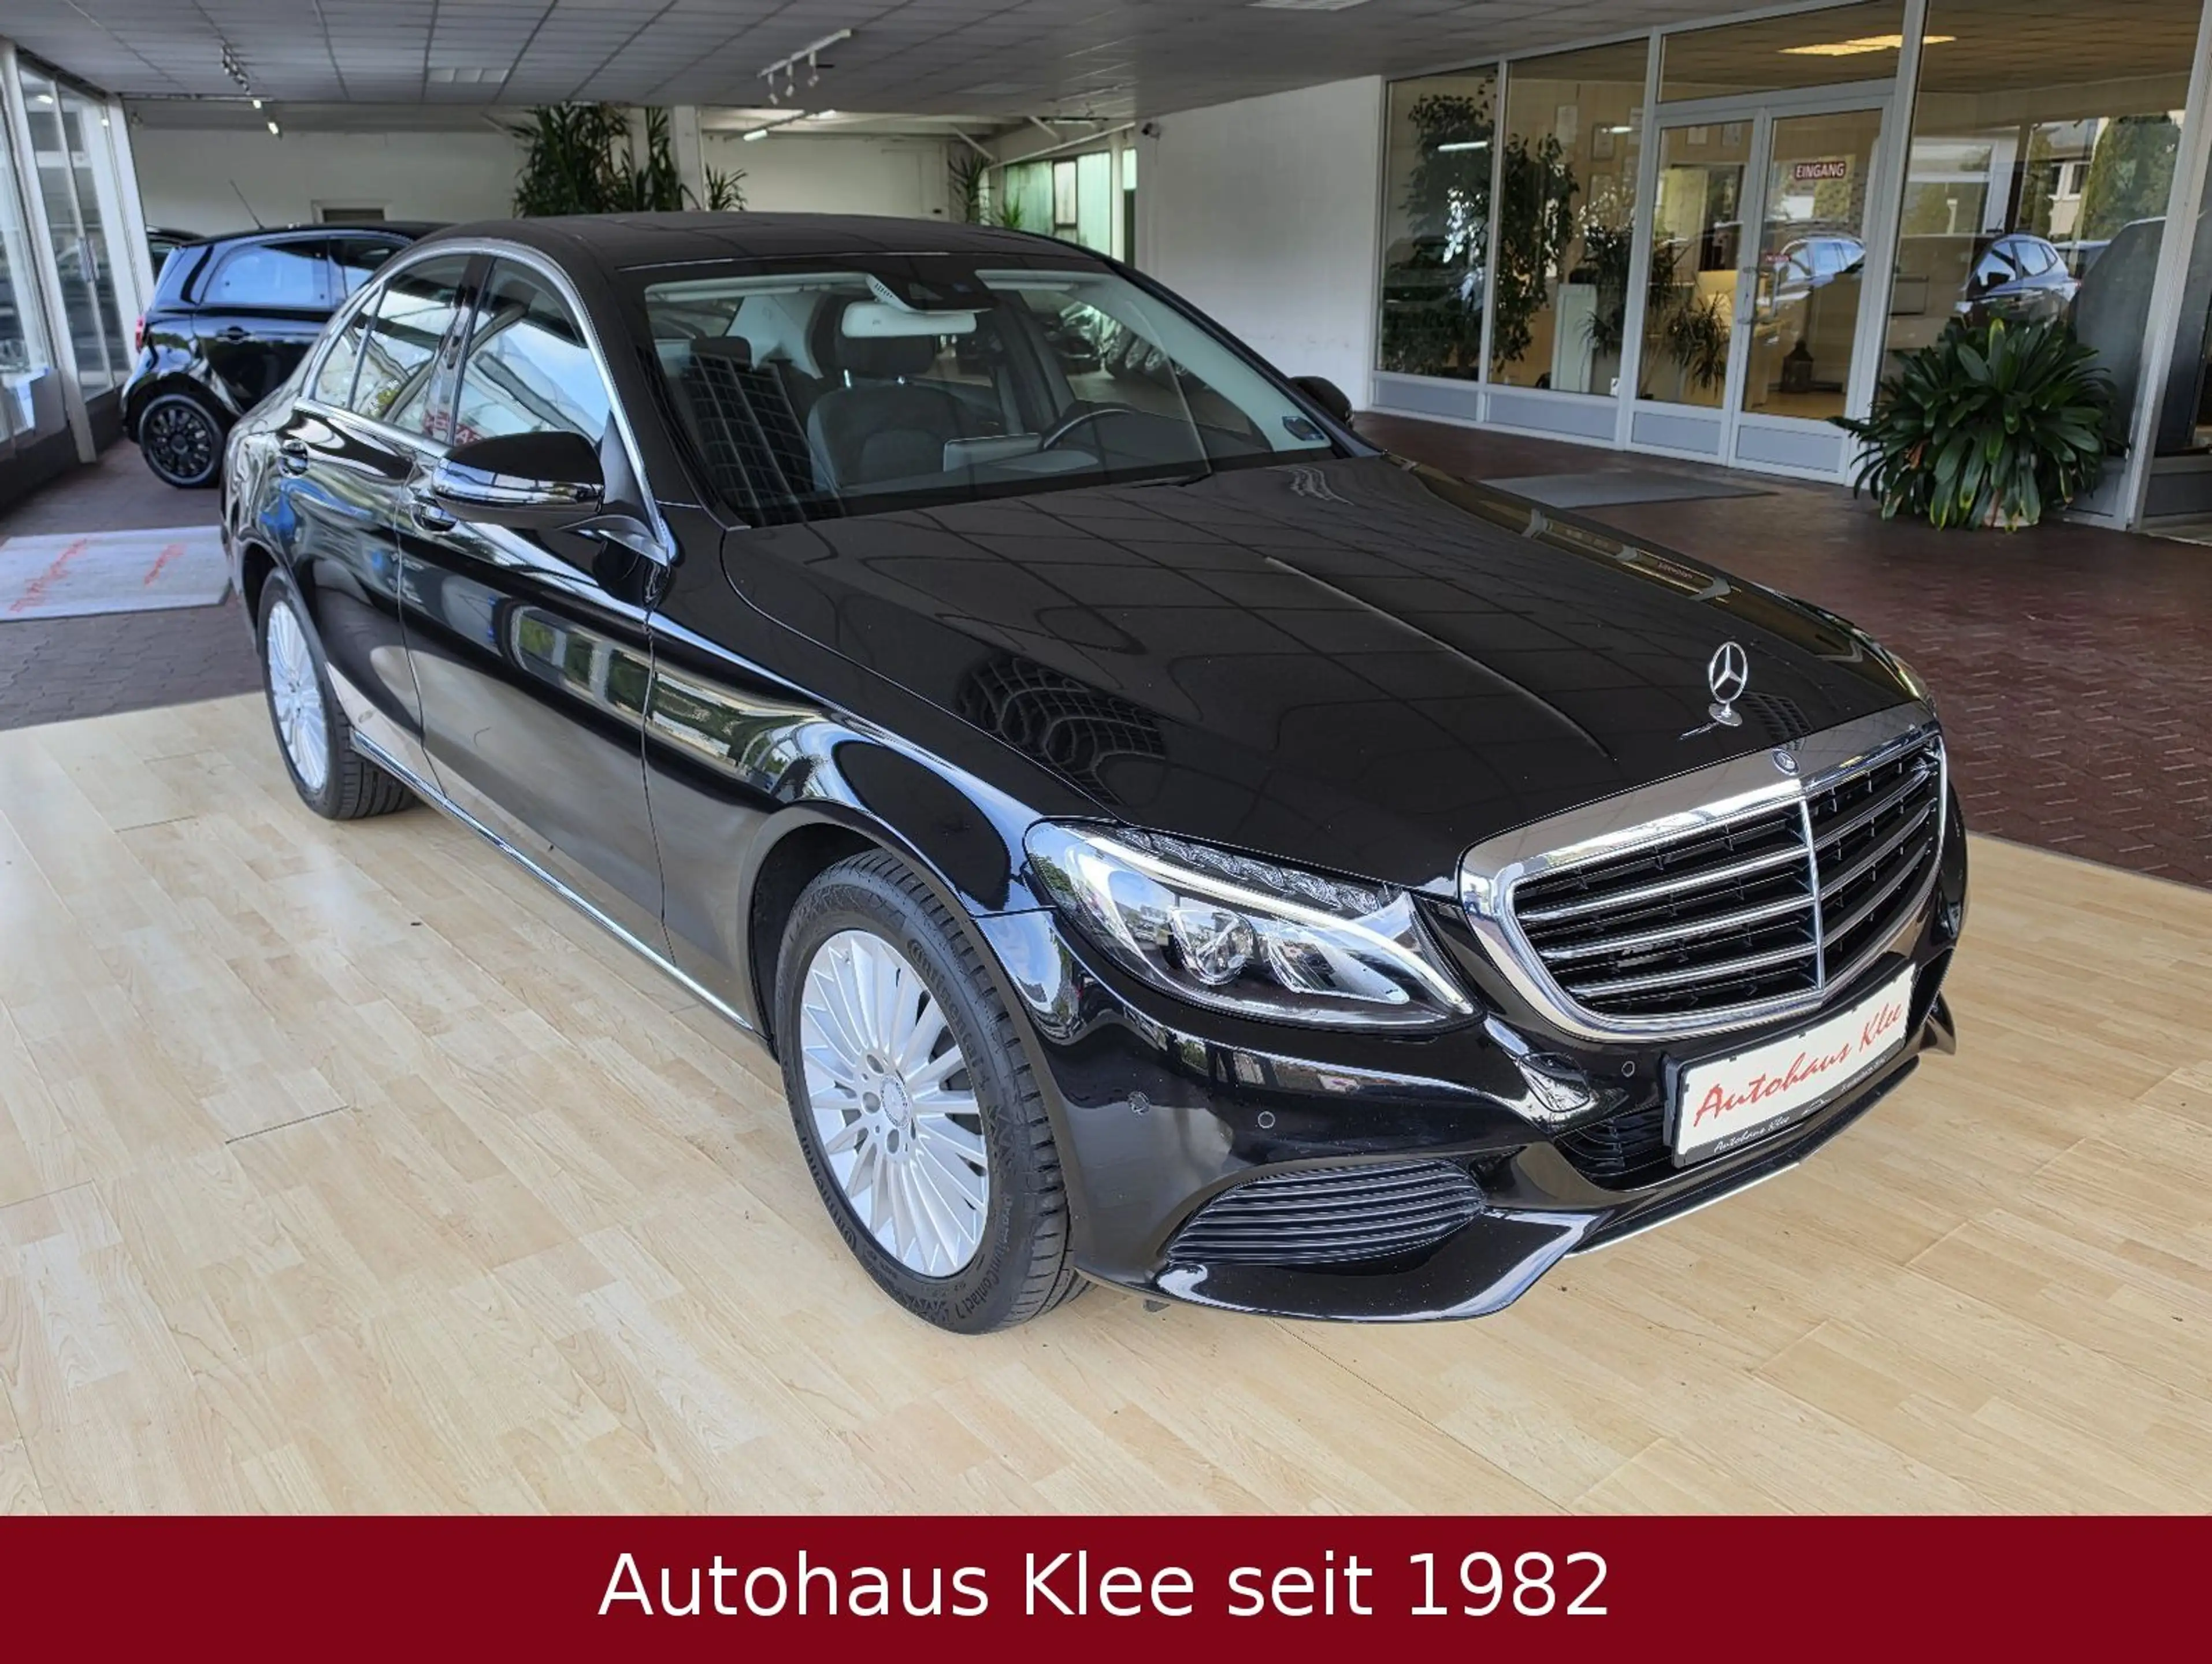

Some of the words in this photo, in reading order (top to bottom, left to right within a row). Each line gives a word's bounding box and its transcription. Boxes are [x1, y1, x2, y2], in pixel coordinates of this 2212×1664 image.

[1795, 162, 1844, 178] EINGANG
[1693, 1043, 1853, 1127] Autohaus
[1858, 1002, 1902, 1053] Klee
